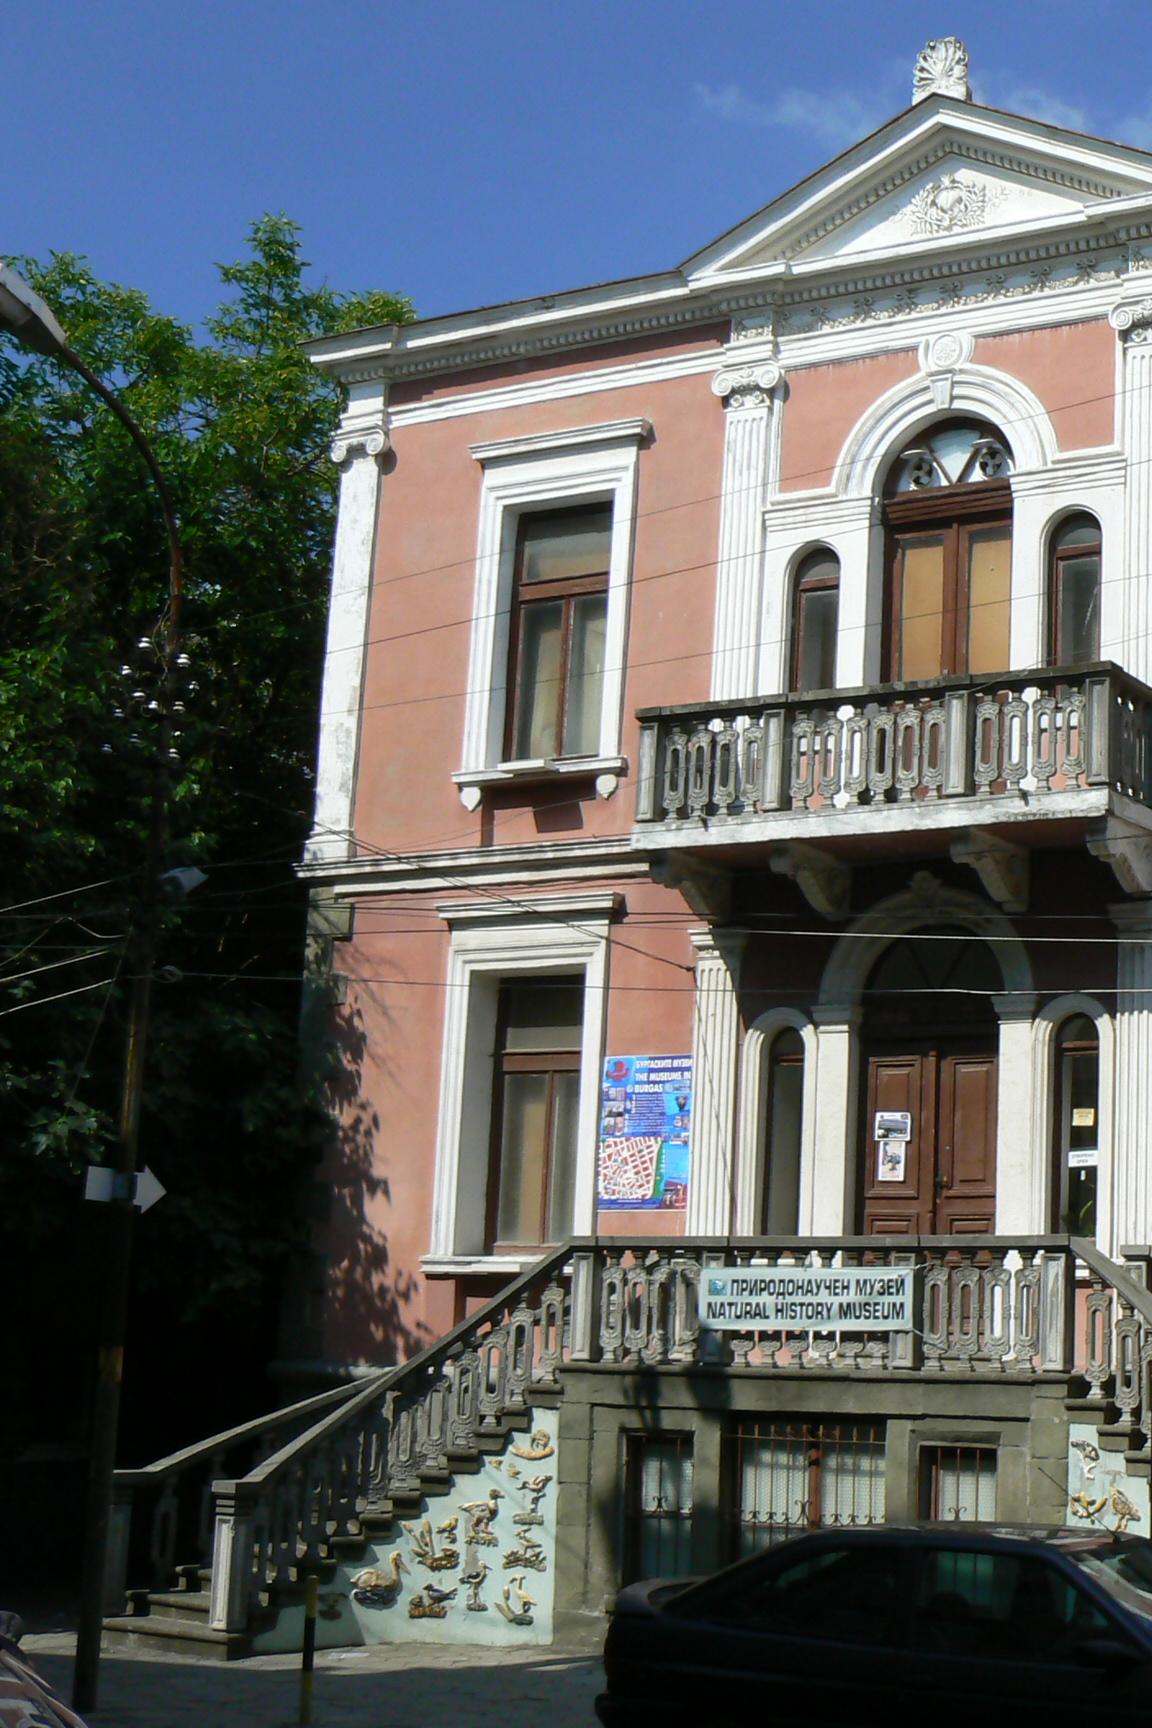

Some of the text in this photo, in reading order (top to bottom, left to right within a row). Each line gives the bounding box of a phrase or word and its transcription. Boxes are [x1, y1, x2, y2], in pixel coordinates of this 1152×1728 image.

[635, 1071, 692, 1081] THE MUSEUMS IN
[634, 1083, 664, 1093] BURGAS
[730, 1274, 905, 1299] ПРИРОДОНАУЧЕН МУЗЕЙ
[707, 1302, 905, 1320] NATURAL HISTORY MUSEUM
